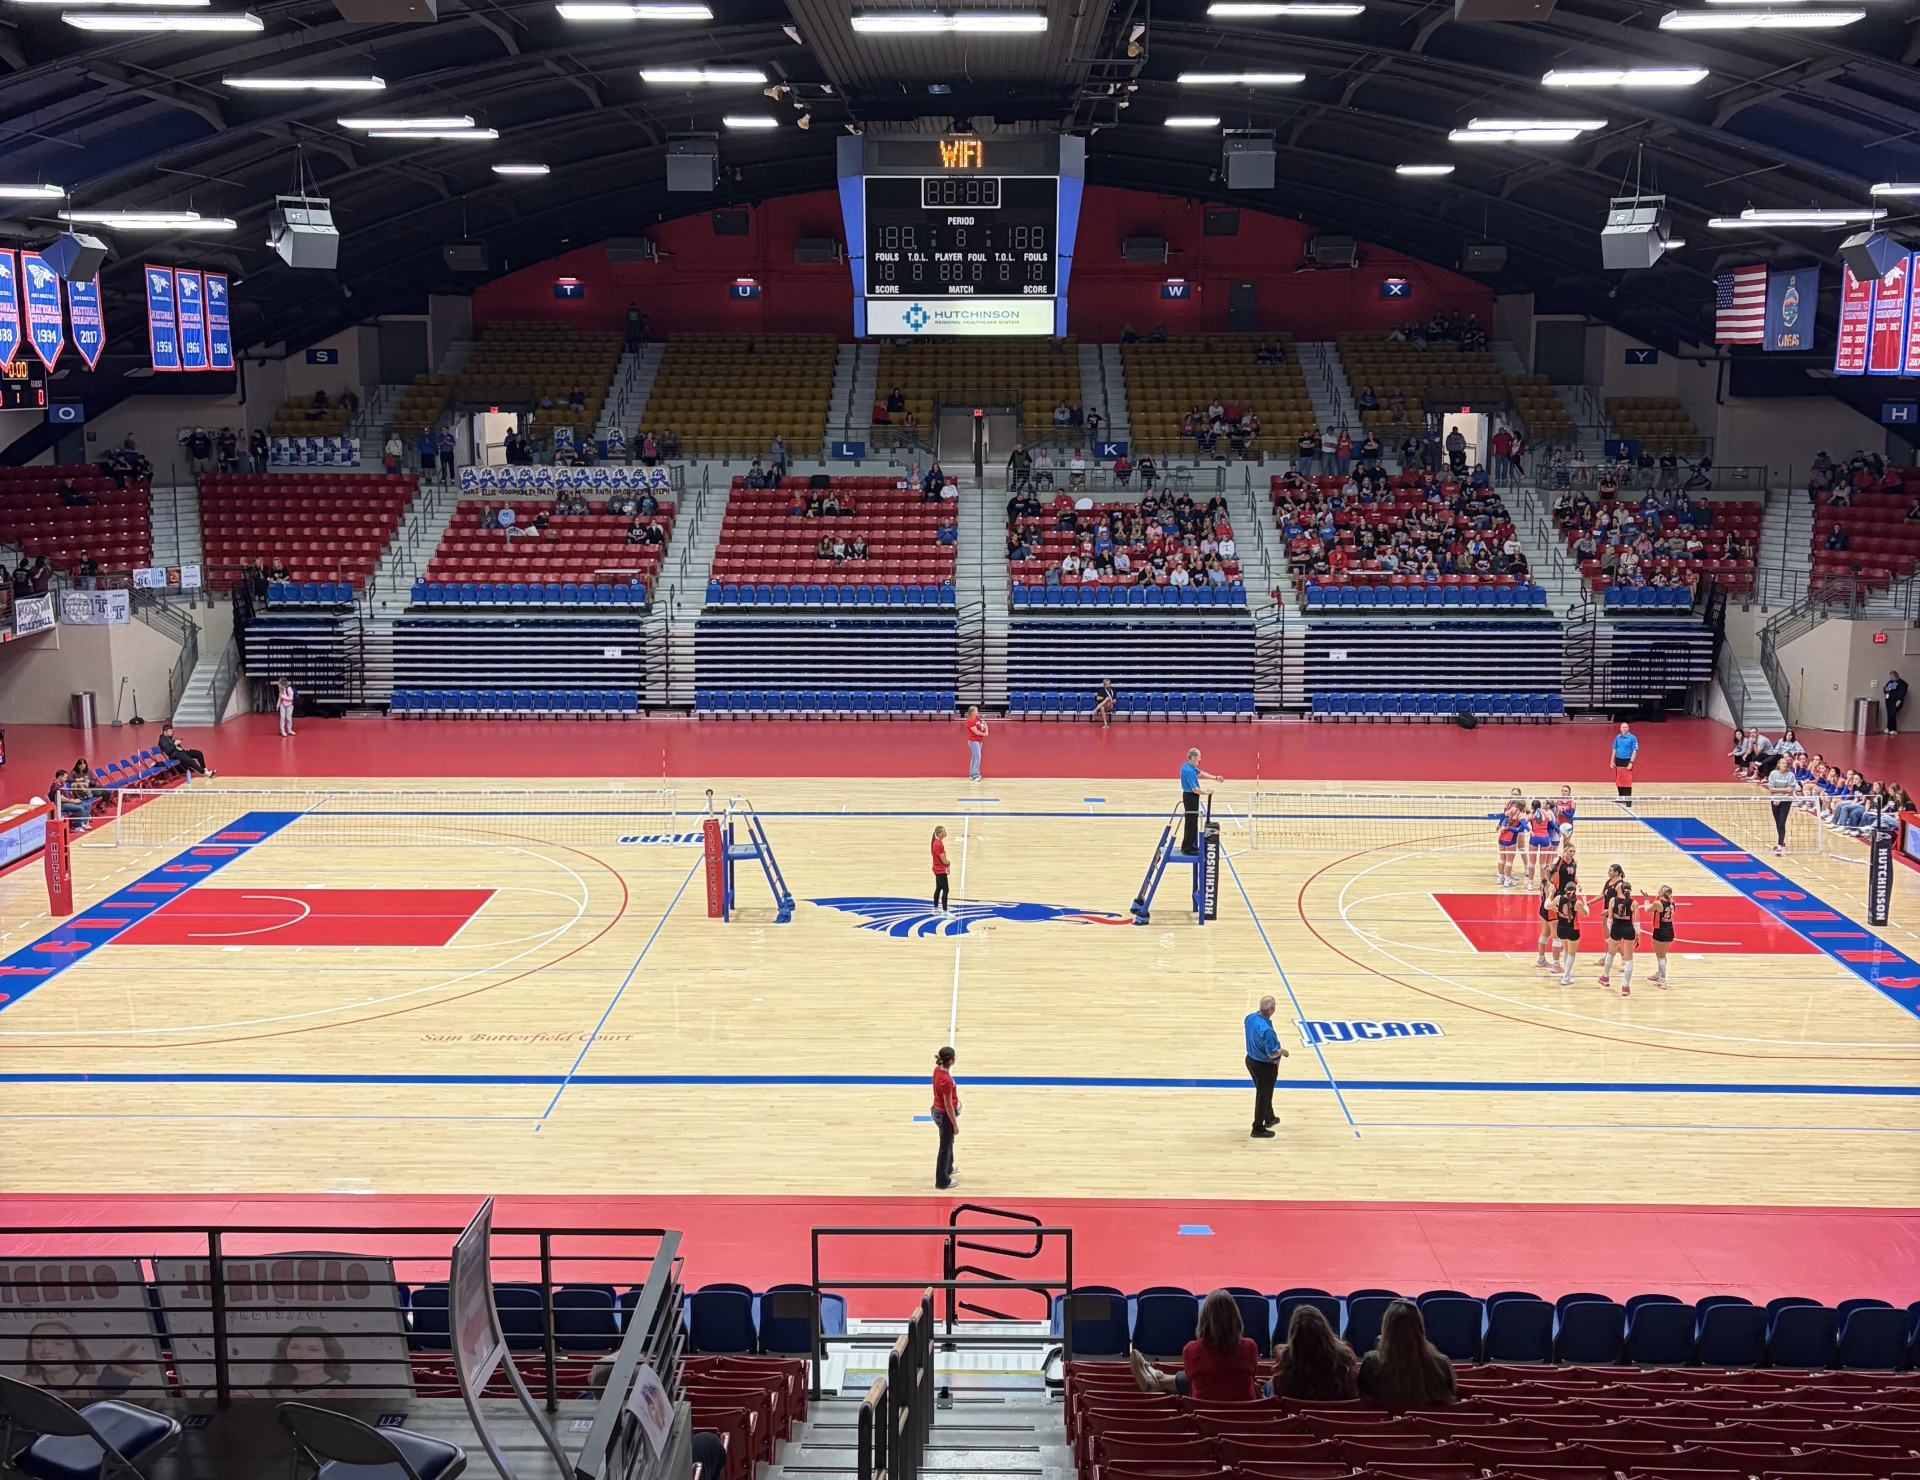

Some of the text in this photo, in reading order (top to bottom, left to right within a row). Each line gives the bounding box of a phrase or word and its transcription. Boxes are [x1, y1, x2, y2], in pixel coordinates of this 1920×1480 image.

[939, 139, 983, 168] WIFI
[947, 216, 975, 225] PERIOD
[875, 252, 899, 262] FOULS
[907, 253, 929, 262] T.O.L.
[935, 252, 987, 262] PLAYER FOUL
[995, 253, 1016, 262] T.O.L.
[1024, 252, 1048, 262] FOULS
[563, 285, 575, 296] T
[738, 286, 750, 297] U
[875, 285, 900, 294] SCORE
[948, 285, 974, 294] MATCH
[1023, 285, 1048, 294] SCORE
[1168, 286, 1183, 296] W
[1389, 284, 1403, 295] X
[934, 310, 1020, 319] HUTCHINSON
[37, 328, 57, 344] 1994
[80, 330, 98, 344] 2017
[316, 351, 329, 362] S
[1635, 351, 1649, 362] Y
[58, 407, 75, 421] O
[1891, 407, 1908, 420] H
[843, 444, 854, 455] L
[1104, 444, 1118, 455] K
[95, 598, 125, 619] TLT
[707, 825, 716, 854] BLUE
[51, 842, 61, 893] HUTCH
[1204, 843, 1217, 915] HUTCHINSON
[709, 865, 718, 915] DRAGONS
[1874, 848, 1889, 922] HUTCHINSON
[420, 1032, 635, 1044] Sam Butterfield Court
[1297, 1020, 1442, 1045] NJCAA
[379, 1415, 402, 1426] LL2
